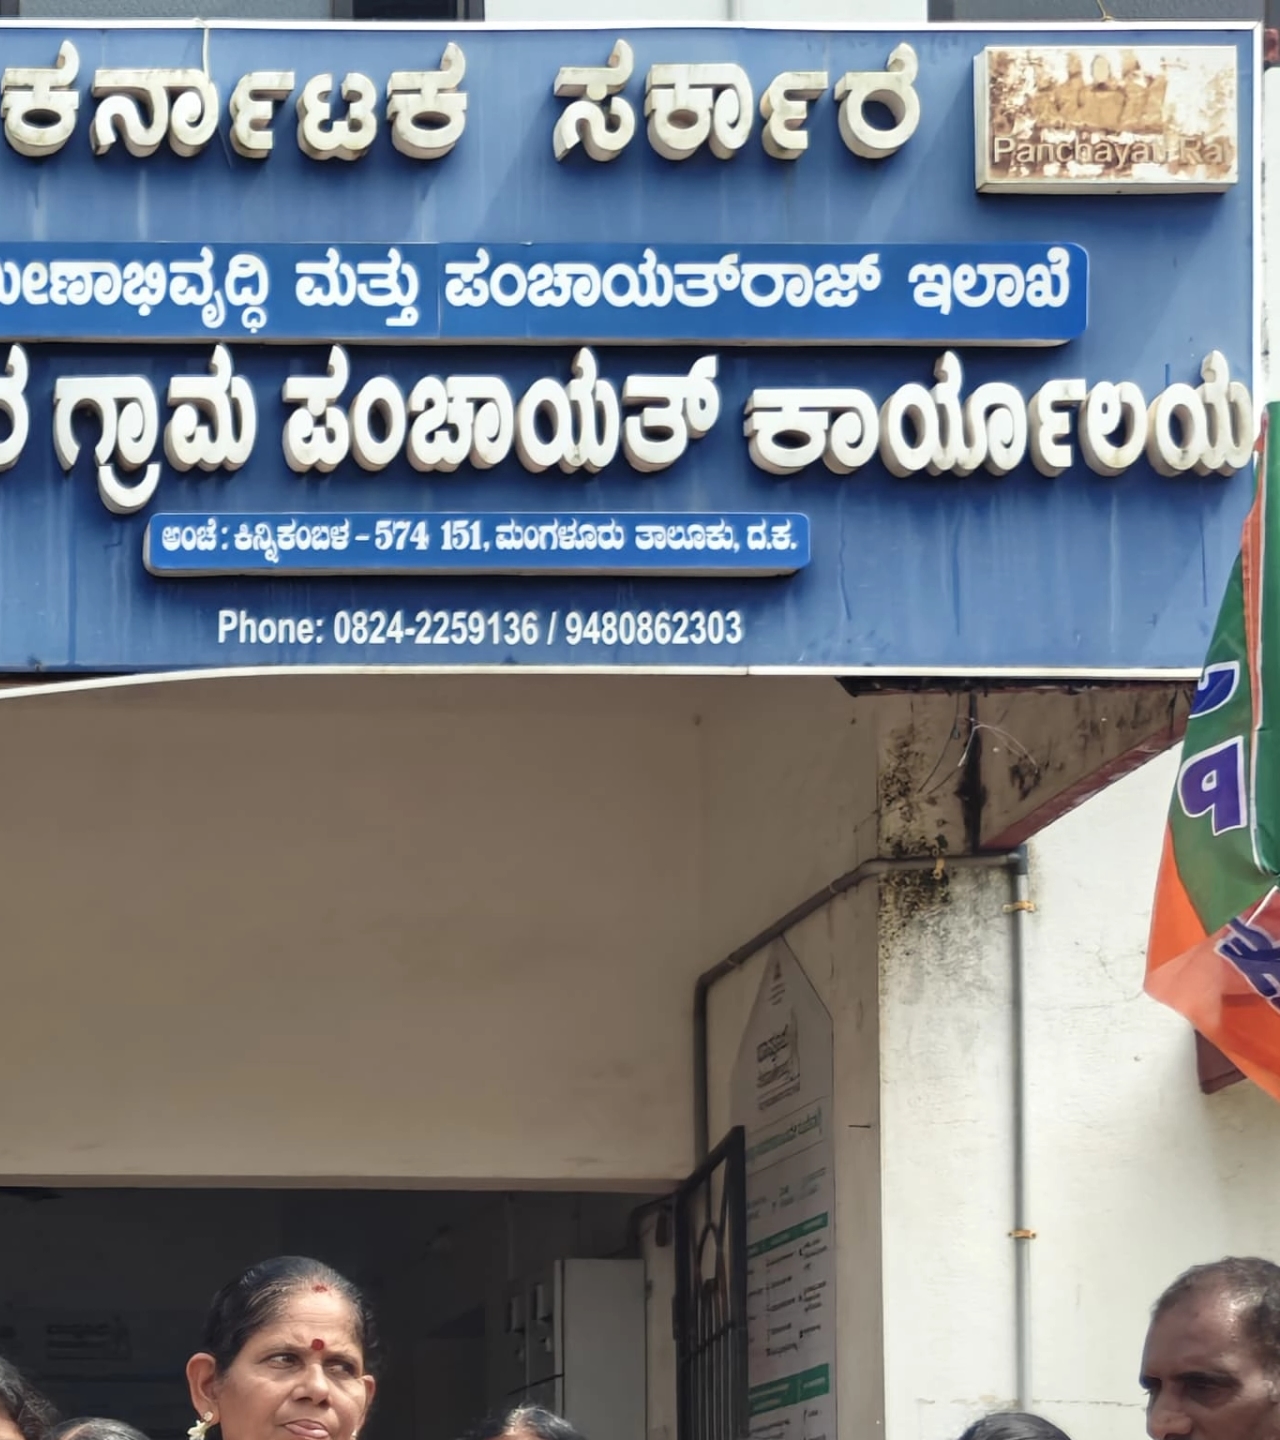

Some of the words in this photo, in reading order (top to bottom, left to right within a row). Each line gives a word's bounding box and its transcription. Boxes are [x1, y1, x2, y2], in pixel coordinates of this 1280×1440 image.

[0, 40, 467, 160] ಕರ್ನಾಟಕ
[553, 38, 920, 161] ಸರ್ಕಾರ
[295, 246, 421, 327] ಮತ್ತು
[908, 246, 1070, 315] ಇಲಾಖೆ
[53, 344, 257, 515] ಗ್ರಾಮ
[283, 344, 719, 474] ಪಂಚಾಯತ್
[495, 517, 625, 551] ಮಂಗಳೂರು
[217, 609, 324, 644] Phone:
[333, 610, 539, 646] 0824-2259136
[565, 610, 743, 646] 9480862303
